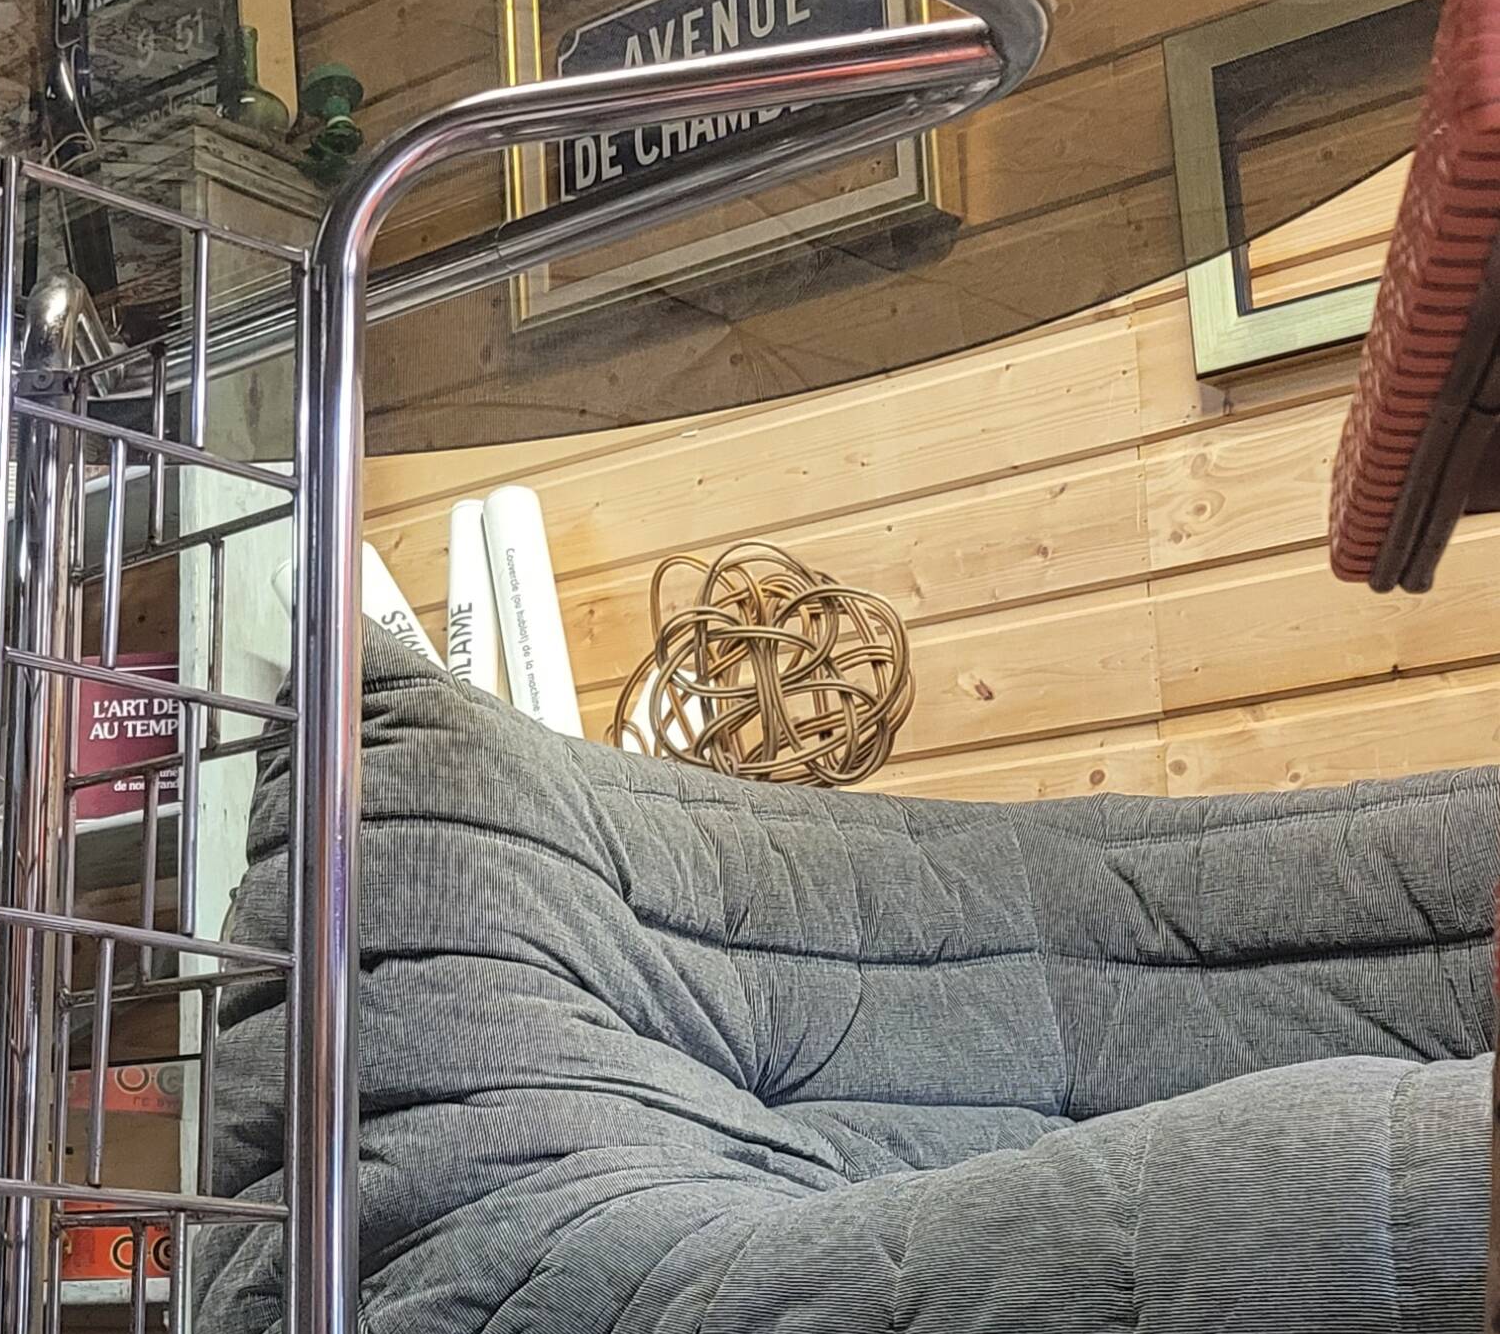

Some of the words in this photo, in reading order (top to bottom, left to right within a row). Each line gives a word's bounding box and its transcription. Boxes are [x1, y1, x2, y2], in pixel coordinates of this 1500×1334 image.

[174, 7, 205, 52] 51
[575, 131, 623, 191] DE
[450, 602, 473, 684] ILAME
[522, 644, 533, 658] de
[93, 698, 148, 719] L'ART
[89, 722, 118, 740] AU
[113, 780, 125, 792] de
